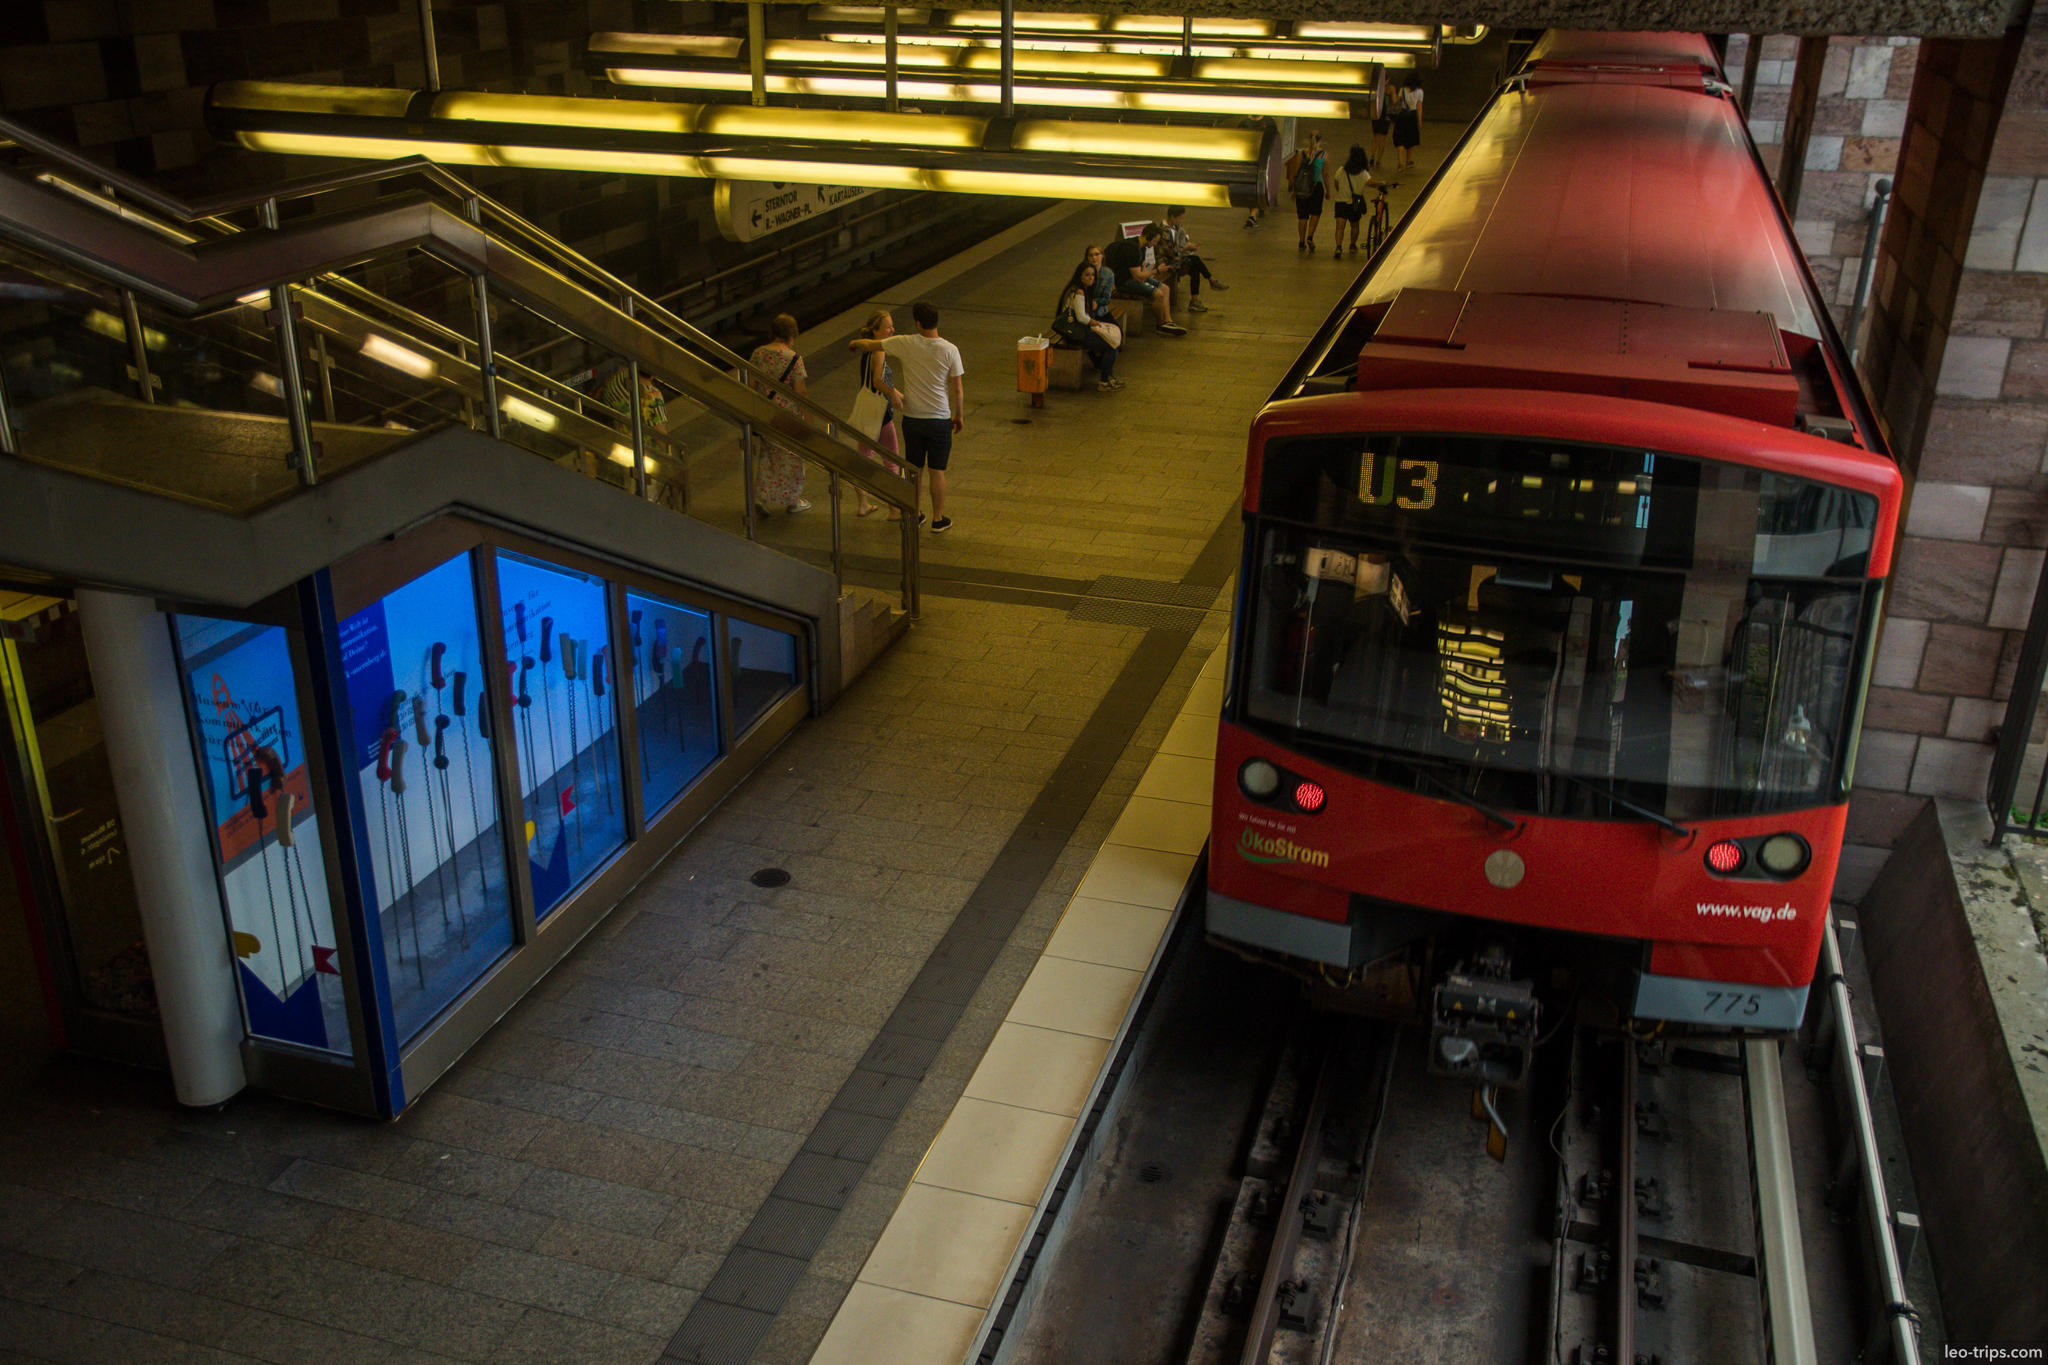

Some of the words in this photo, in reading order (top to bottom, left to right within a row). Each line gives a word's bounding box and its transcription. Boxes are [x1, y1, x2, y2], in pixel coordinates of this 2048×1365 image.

[765, 190, 798, 213] STERNTOR
[1358, 452, 1439, 509] U3
[1240, 825, 1329, 868] ÖkoStrom
[1696, 902, 1797, 923] www.vag.de
[1703, 990, 1762, 1016] 775
